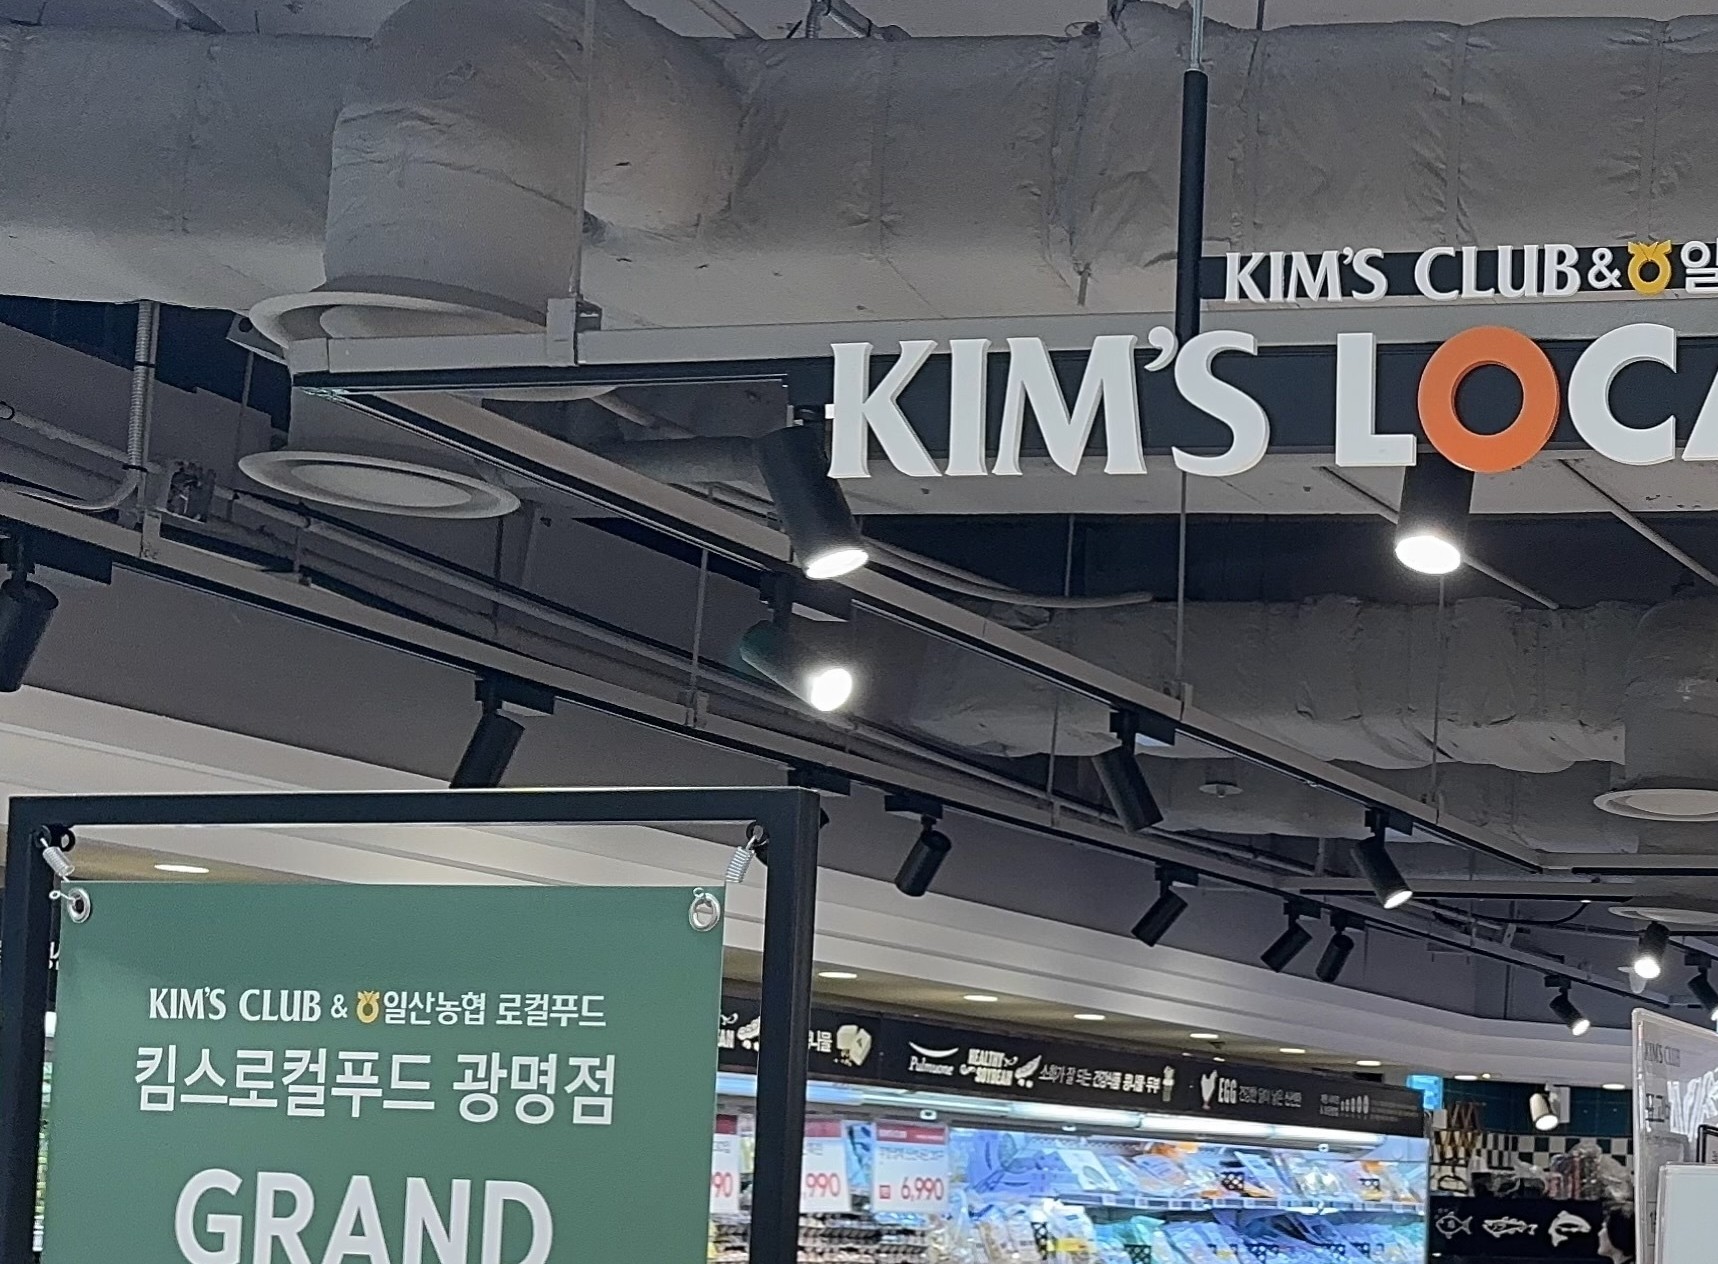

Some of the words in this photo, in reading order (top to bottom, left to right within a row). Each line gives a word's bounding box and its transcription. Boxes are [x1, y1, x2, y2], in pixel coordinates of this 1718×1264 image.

[1224, 246, 1389, 304] KIM'S
[828, 325, 1270, 479] KIM'S
[148, 987, 227, 1021] KIM'S
[239, 988, 322, 1022] CLUB
[331, 998, 348, 1019] &
[383, 991, 485, 1025] 일산농협
[495, 993, 606, 1027] 로컬푸드
[808, 1029, 833, 1053] 나물
[135, 1044, 435, 1118] 킴스로컬푸드
[453, 1053, 616, 1125] 광명점
[1218, 1077, 1237, 1104] EGG
[901, 1177, 944, 1201] 6,990
